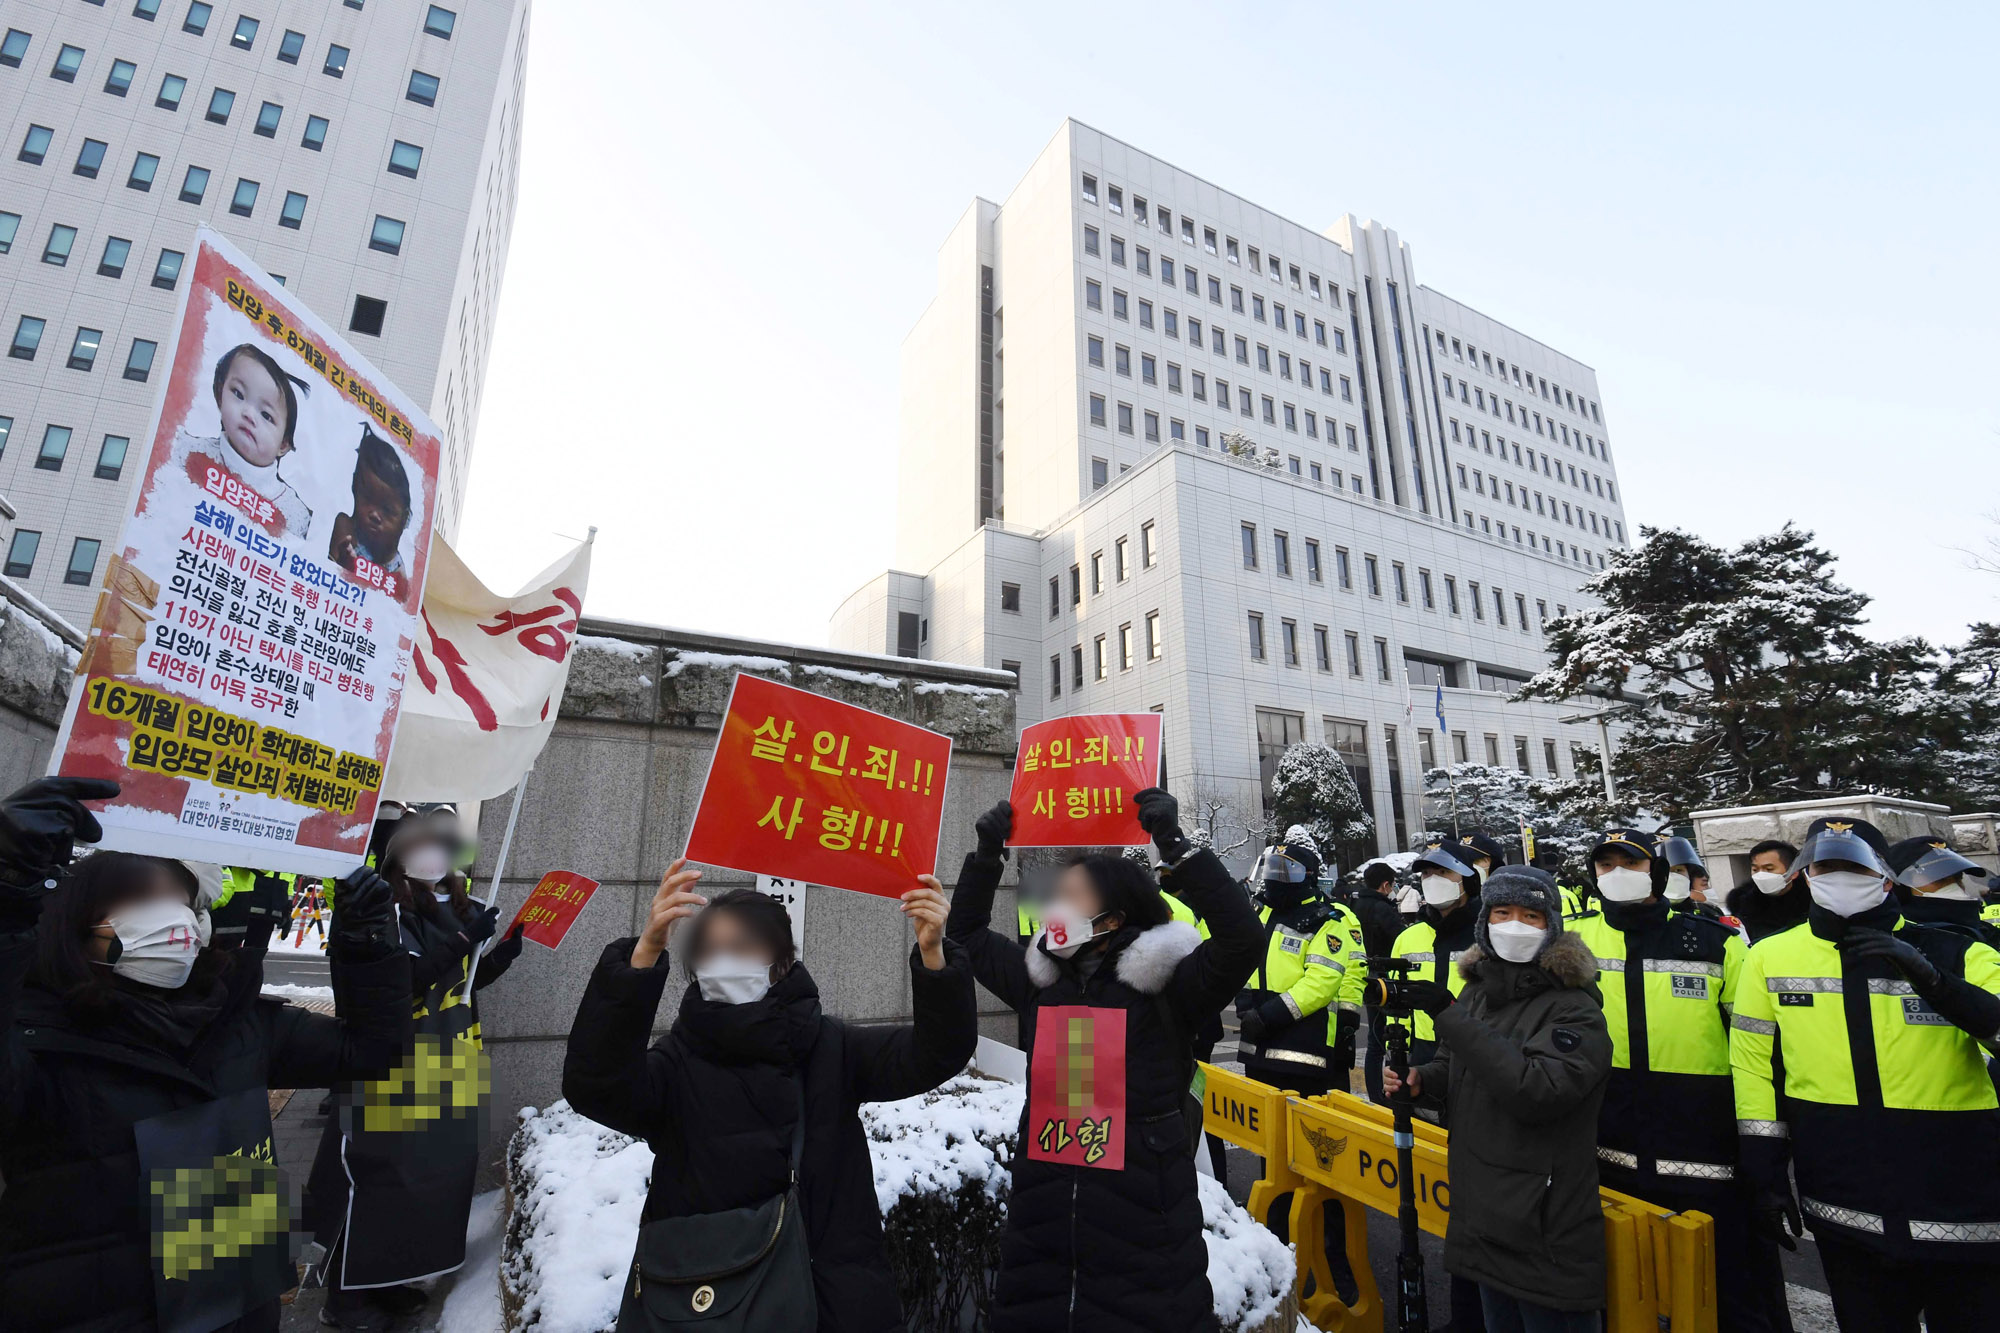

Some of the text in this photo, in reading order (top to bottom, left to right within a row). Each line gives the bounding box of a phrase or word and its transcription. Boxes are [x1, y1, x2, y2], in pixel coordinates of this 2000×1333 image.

[227, 280, 413, 445] 입양 후 8개월 간 학대의 흔적
[204, 467, 276, 524] 입양직후
[182, 526, 374, 635] 사망에 이르는 폭행 1시간 후
[193, 500, 367, 607] 살해 의도가 없었다고?!
[354, 558, 397, 596] 입양 후
[168, 574, 367, 675] 의식을 잃고 호흡 곤란임에도
[176, 548, 376, 659] 전신골절, 전신 멍, 내장파열로
[147, 650, 299, 719] 태연히 어묵 공구한
[155, 624, 315, 702] 입양아 혼수상태일 때
[164, 601, 374, 702] 119가 아닌 택시를 타고 병원행
[91, 682, 381, 789] 16개월 입양아 학대하고 살해한
[751, 715, 934, 796] 살.인.죄.!!
[1023, 735, 1145, 772] 살.인.죄.!!
[131, 732, 358, 811] 입양모 살인죄 처벌하라!
[1031, 786, 1123, 819] 사 형!!!
[182, 809, 295, 842] 대한아동학대방지협회
[757, 795, 904, 858] 사 형!!!
[1674, 989, 1705, 997] POLICE
[1906, 999, 1920, 1012] 경
[1908, 1014, 1944, 1022] POLIC
[1211, 1091, 1259, 1133] LINE
[1359, 1149, 1451, 1213] POIC
